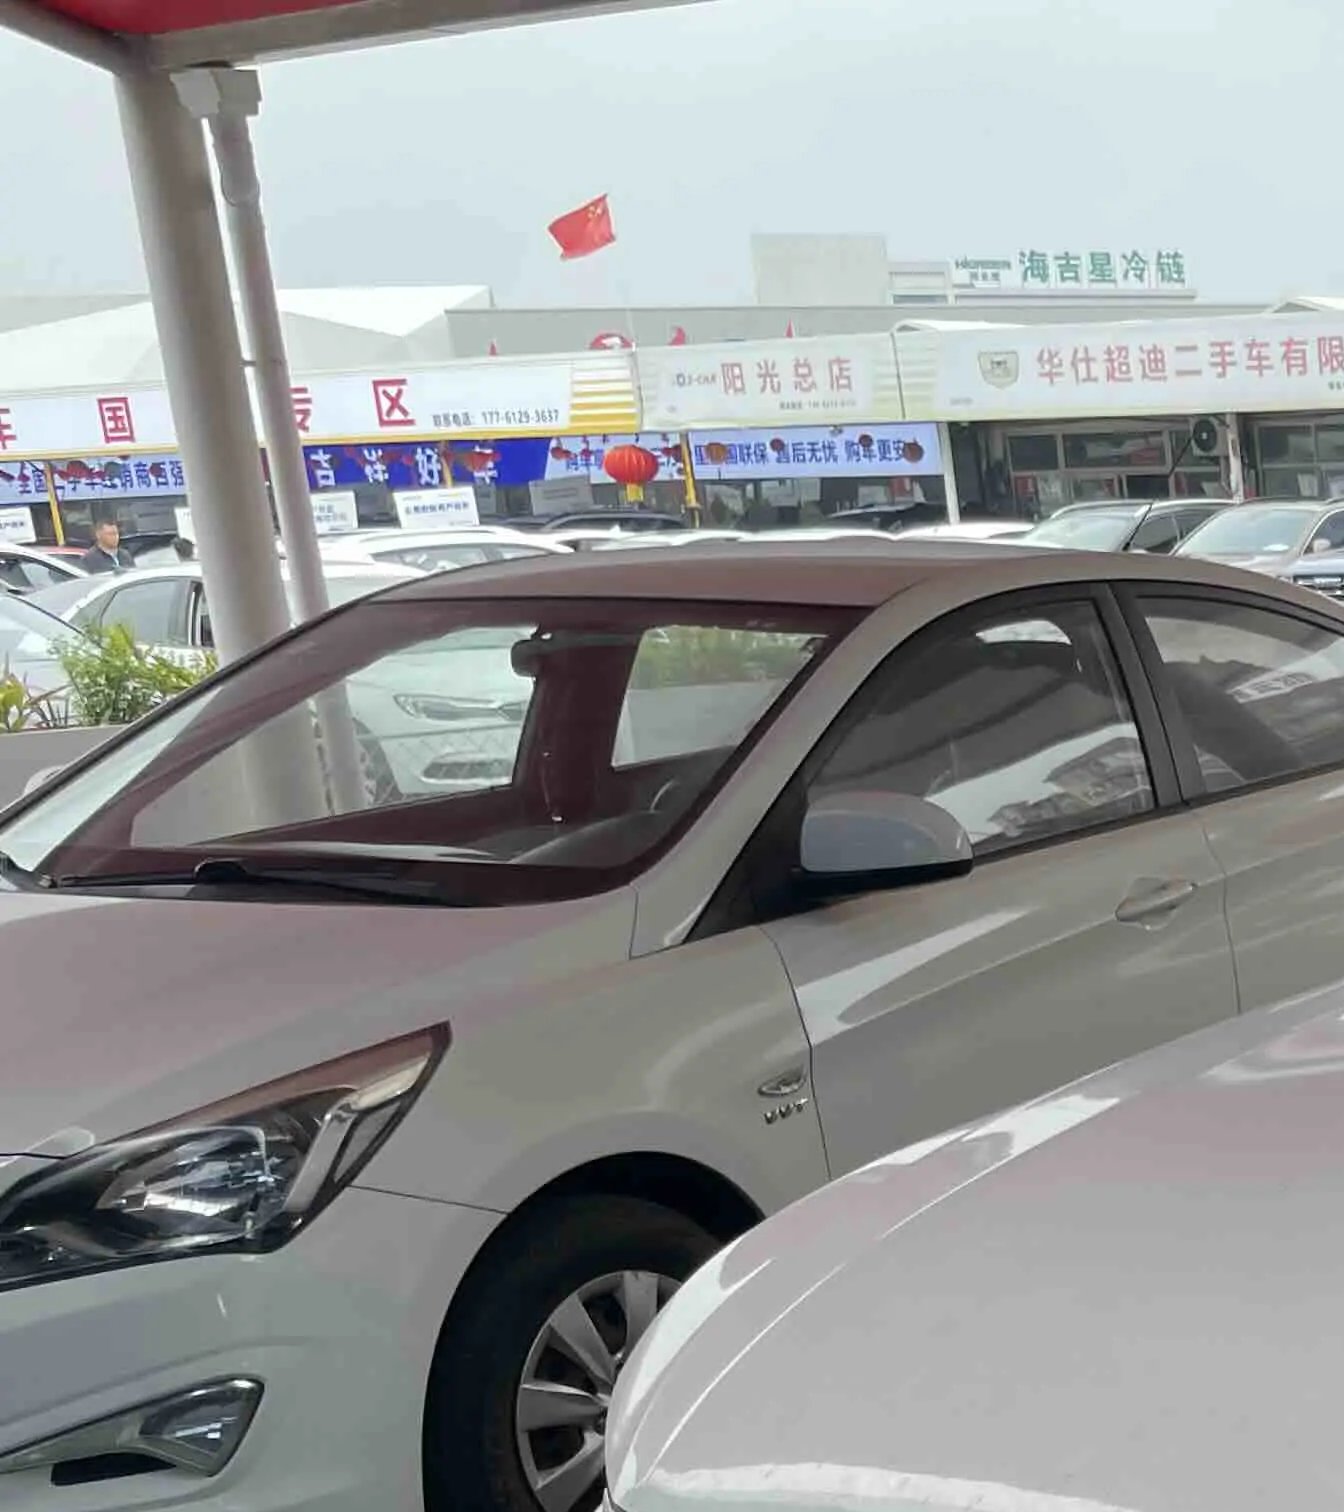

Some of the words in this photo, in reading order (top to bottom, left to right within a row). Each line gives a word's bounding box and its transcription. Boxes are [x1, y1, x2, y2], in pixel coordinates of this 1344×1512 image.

[1018, 250, 1186, 283] 海吉星冷链
[720, 357, 853, 396] 阳光总店
